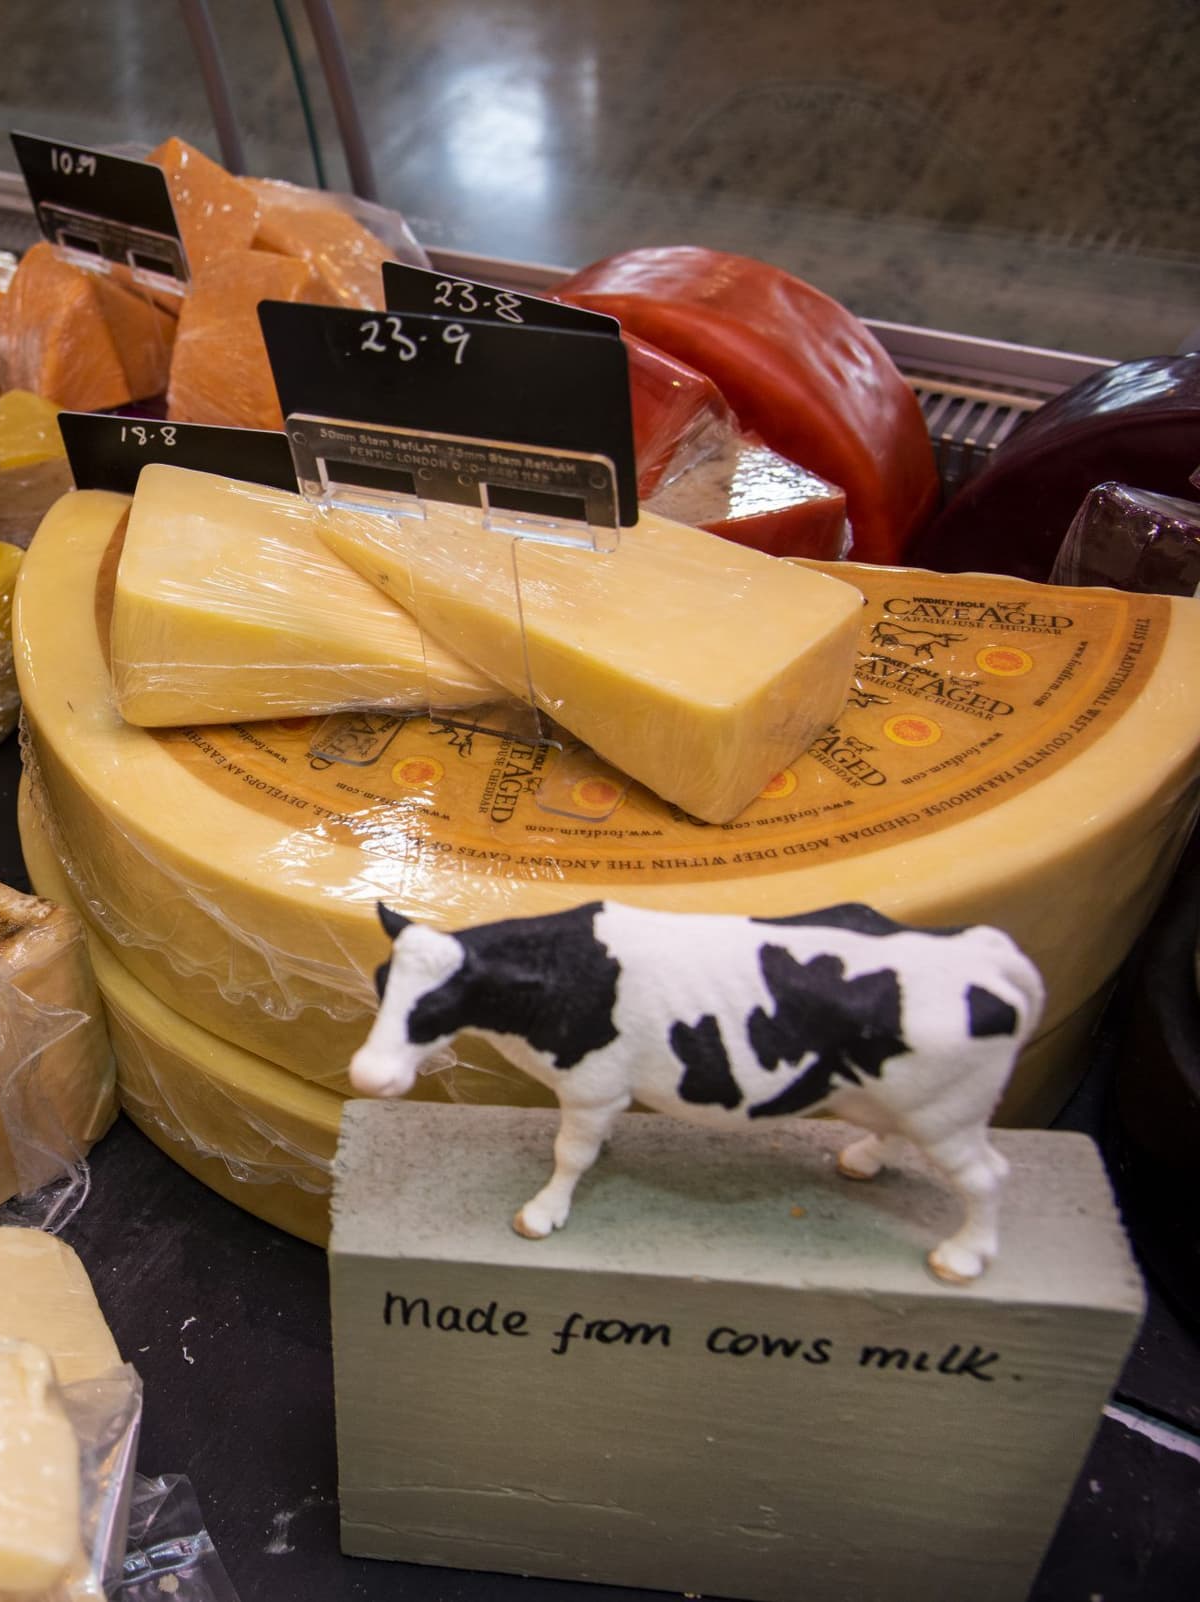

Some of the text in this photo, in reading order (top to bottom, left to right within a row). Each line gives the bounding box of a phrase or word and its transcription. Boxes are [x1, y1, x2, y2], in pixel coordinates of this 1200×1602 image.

[883, 598, 1074, 630] CAVE AGED
[956, 600, 986, 609] HOLE
[897, 615, 1063, 636] ARMHOUSE CHEDDAR
[1132, 617, 1152, 641] THIS
[853, 670, 995, 721] RMHOUSE CHEDDAR
[854, 658, 1015, 716] AVE AGED
[1070, 708, 1102, 734] WEST
[814, 735, 887, 787] AGED
[901, 732, 1004, 786] www.fordfarm.com
[1014, 732, 1074, 775] COUNTRY
[224, 762, 243, 777] AN
[807, 748, 862, 789] CHEDDAR
[242, 772, 308, 811] DEVELOPS
[490, 760, 534, 824] AGED
[920, 769, 1016, 818] FARMHOUSE
[524, 824, 664, 839] www.fordfarm.com
[834, 811, 922, 844] CHEDDAR
[456, 845, 511, 862] CAVES
[652, 852, 727, 870] WITHIN
[732, 847, 779, 864] DEEP
[782, 836, 830, 857] AGED
[517, 855, 600, 870] ANCIENT
[607, 859, 645, 870] THE
[552, 1312, 672, 1355] from
[706, 1324, 832, 1365] cows
